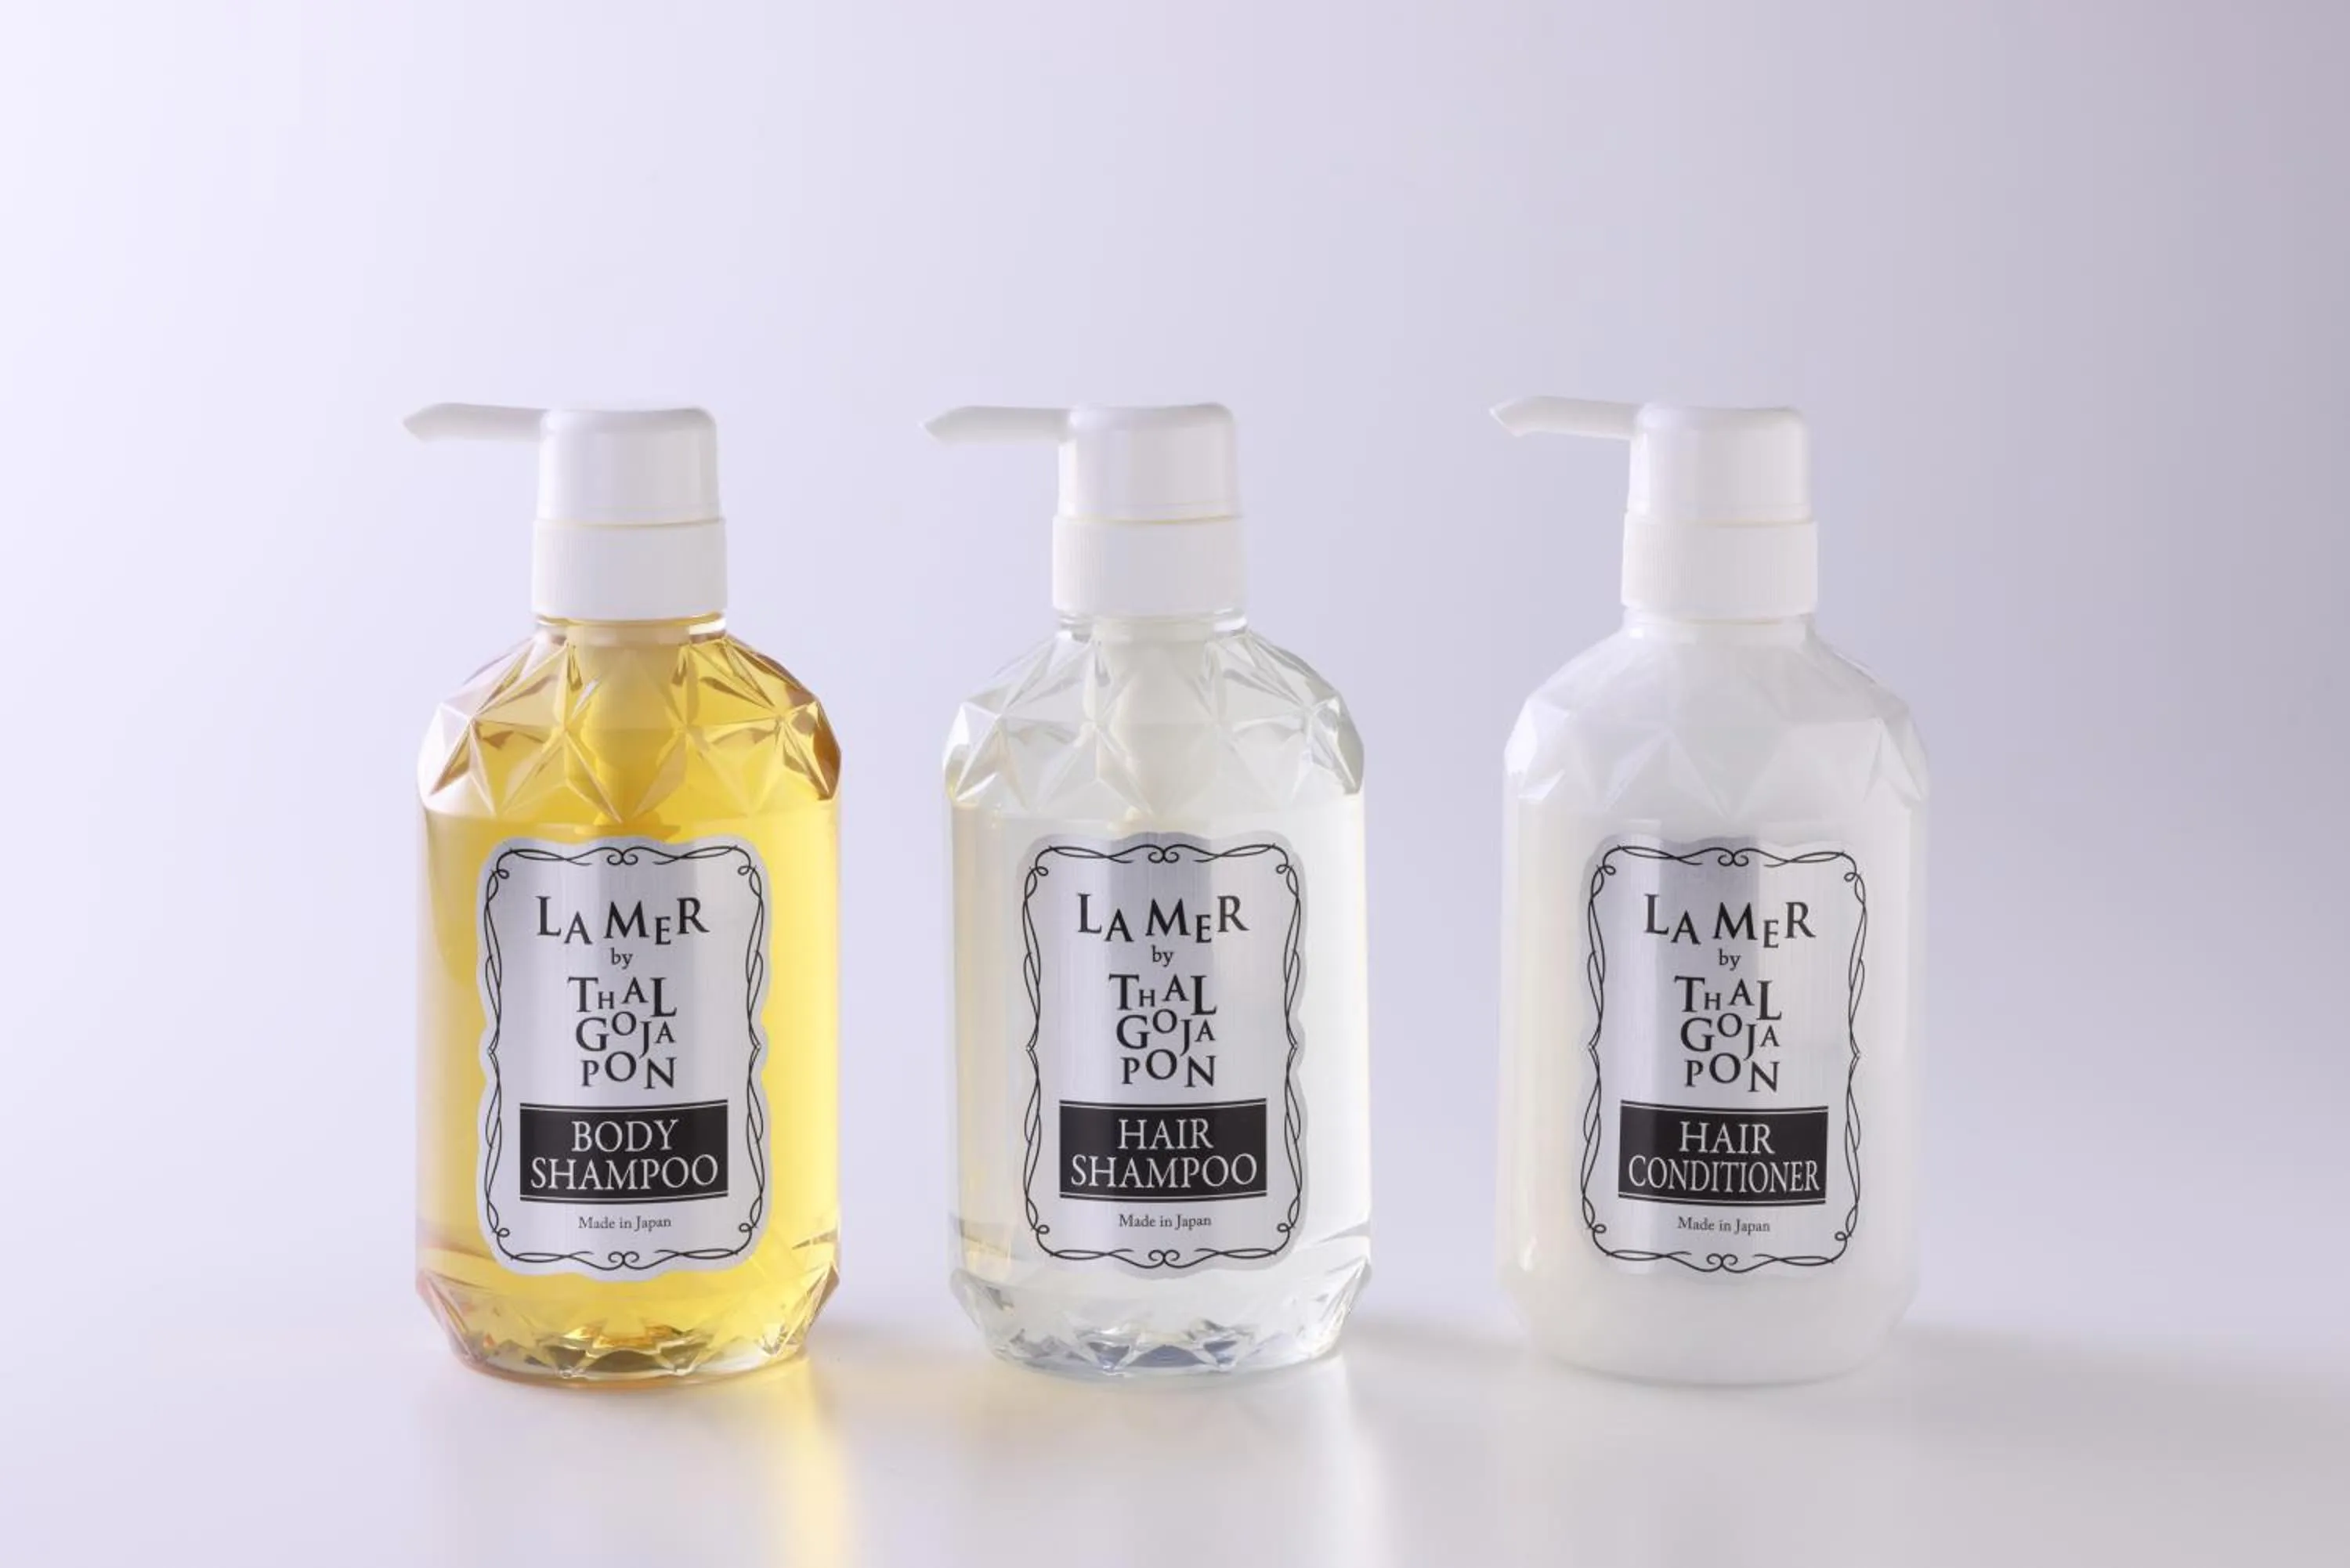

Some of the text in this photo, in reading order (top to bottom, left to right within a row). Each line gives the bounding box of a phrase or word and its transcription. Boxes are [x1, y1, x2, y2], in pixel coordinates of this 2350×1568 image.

[536, 895, 710, 945] LA MER
[1077, 893, 1249, 944] LA MER
[1644, 894, 1817, 948] LA MER
[610, 947, 634, 970] by
[1151, 945, 1174, 968] by
[1718, 948, 1741, 971] by
[568, 976, 678, 1018] THAL
[1108, 974, 1217, 1016] THAL
[1673, 975, 1782, 1021] THAL
[575, 1010, 676, 1059] GOJA
[1116, 1008, 1216, 1057] GOJA
[1680, 1012, 1781, 1061] GOJA
[581, 1050, 678, 1089] PON
[1122, 1048, 1217, 1088] PON
[1684, 1052, 1781, 1093] PON
[570, 1118, 679, 1152] BODY
[1117, 1118, 1213, 1150] HAIR
[1679, 1120, 1775, 1154] HAIR
[530, 1154, 718, 1190] SHAMPOO
[1070, 1152, 1257, 1188] SHAMPOO
[1628, 1154, 1820, 1193] CONDITIONER
[578, 1214, 672, 1232] Made in Japan
[1119, 1213, 1213, 1231] Made in Japan
[1677, 1216, 1770, 1237] Made in Japan
